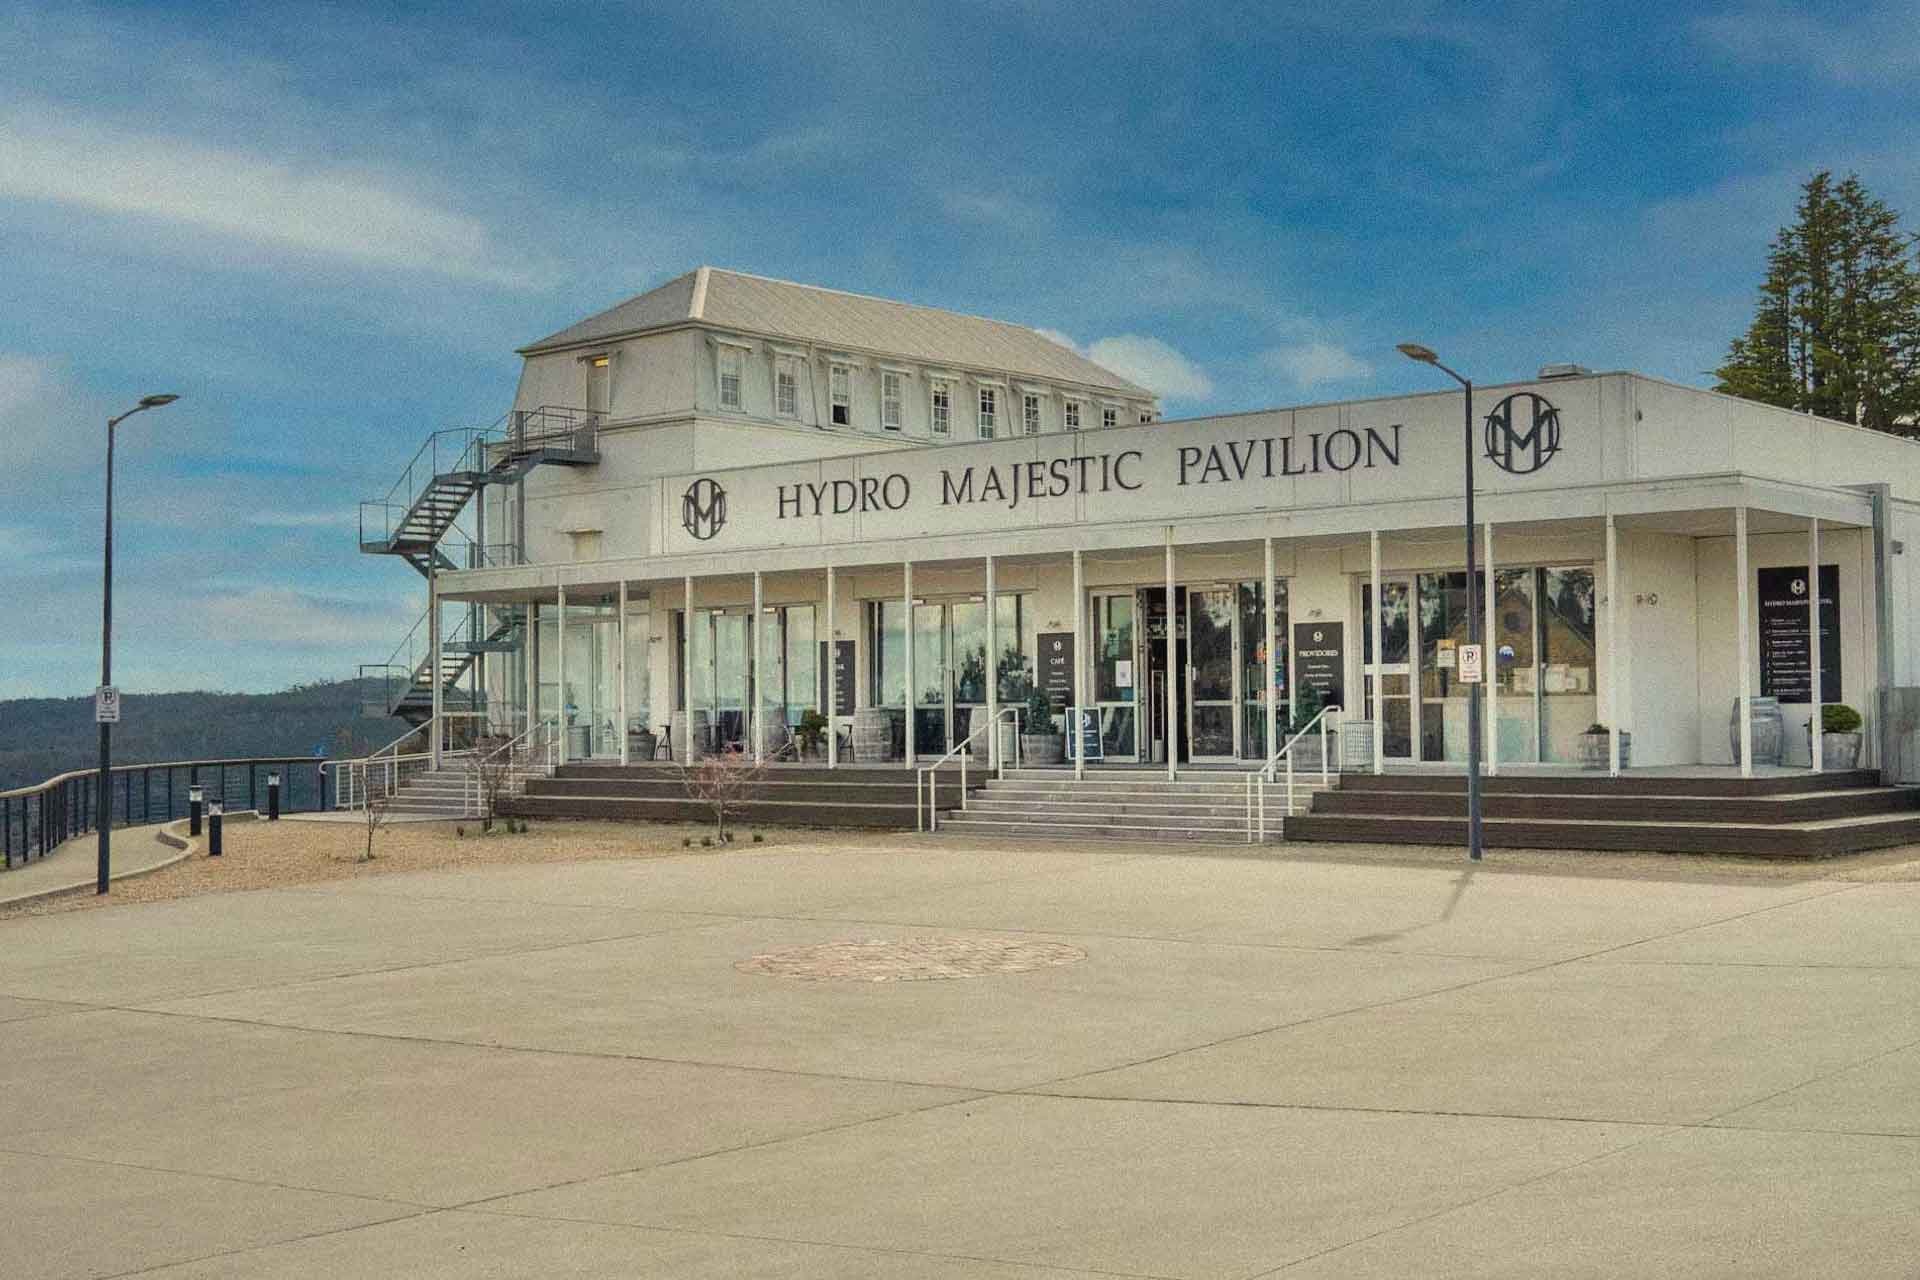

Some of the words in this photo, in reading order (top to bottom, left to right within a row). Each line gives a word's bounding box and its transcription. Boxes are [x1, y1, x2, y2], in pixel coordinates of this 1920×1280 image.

[777, 474, 910, 519] HYDRO
[940, 451, 1143, 509] MAJESTIC
[1177, 424, 1402, 485] PAVILION
